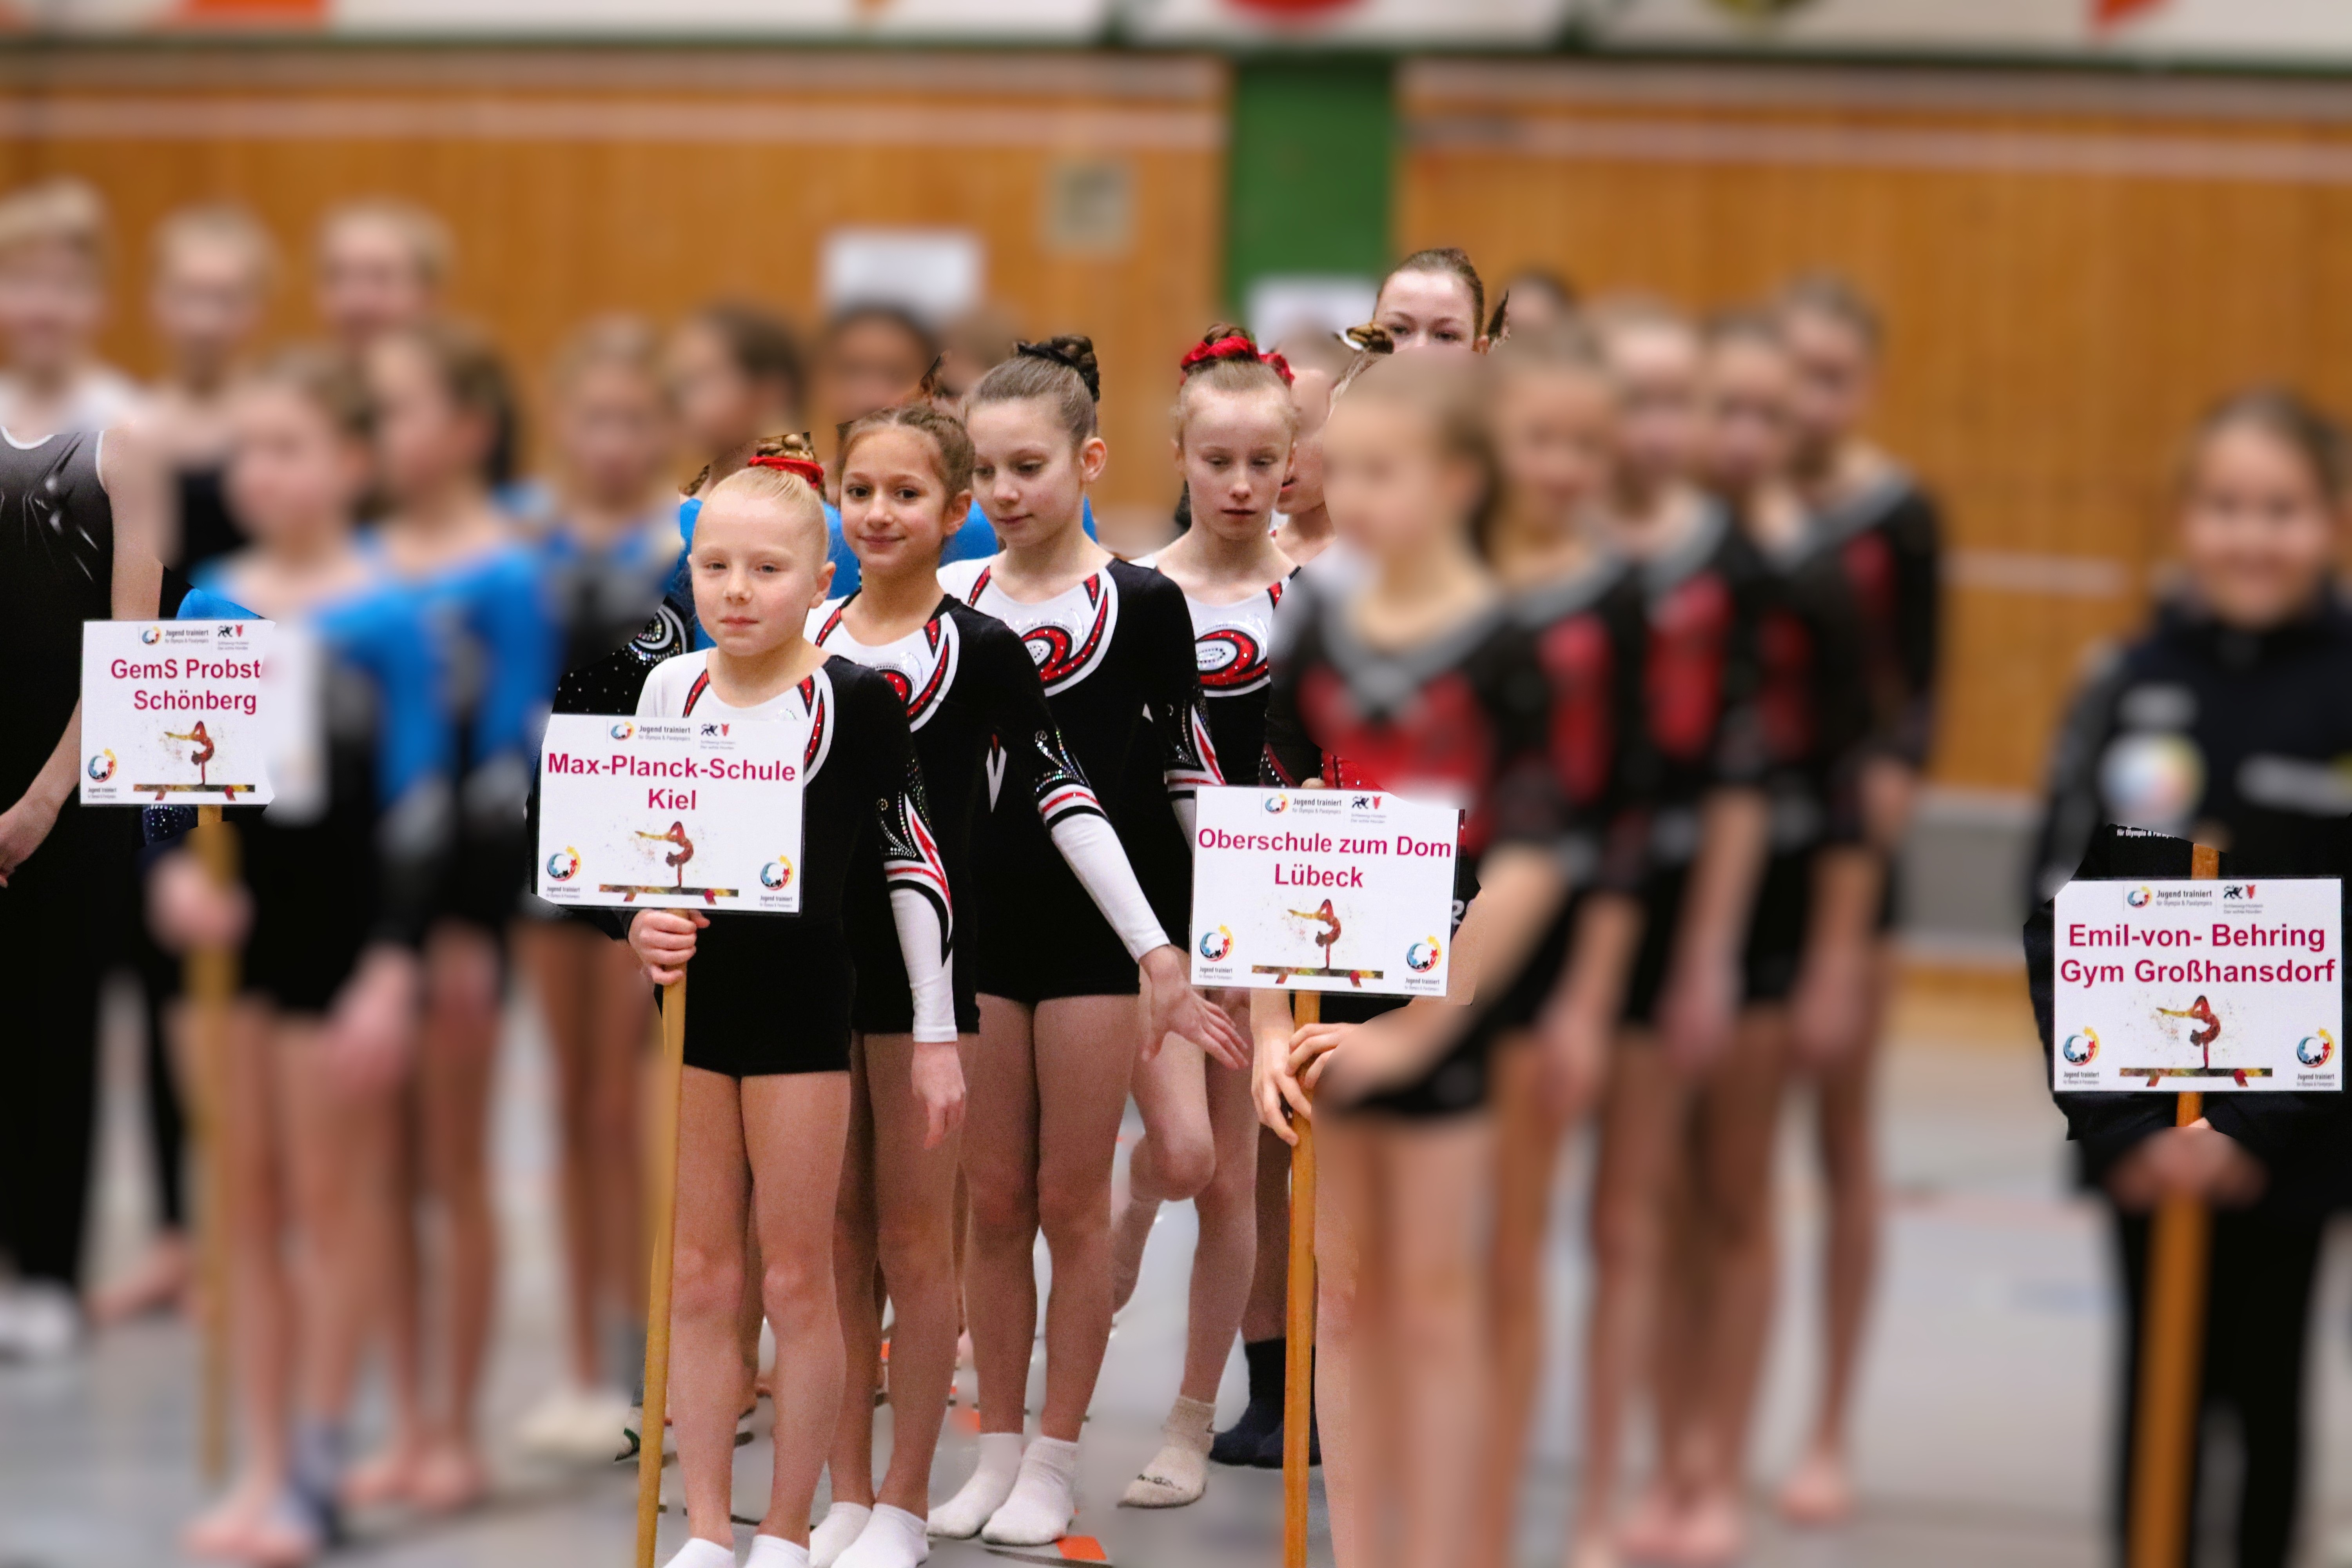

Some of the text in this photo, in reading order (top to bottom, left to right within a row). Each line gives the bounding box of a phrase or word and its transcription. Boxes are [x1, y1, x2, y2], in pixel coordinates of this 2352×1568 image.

[111, 659, 178, 679] GemS
[134, 690, 256, 715] Schönberg
[639, 726, 662, 734] Jugend
[548, 753, 795, 782] Max-Planck-Schule
[648, 788, 696, 810] Kiel
[1293, 798, 1315, 806] Jugend
[1198, 828, 1451, 858] Oberschule zum Dom
[1275, 863, 1363, 888] Lübeck
[2157, 890, 2181, 899] Jugend
[2069, 923, 2325, 953] Emil-von- Behring
[2061, 958, 2336, 988] Gym Großhansdorf
